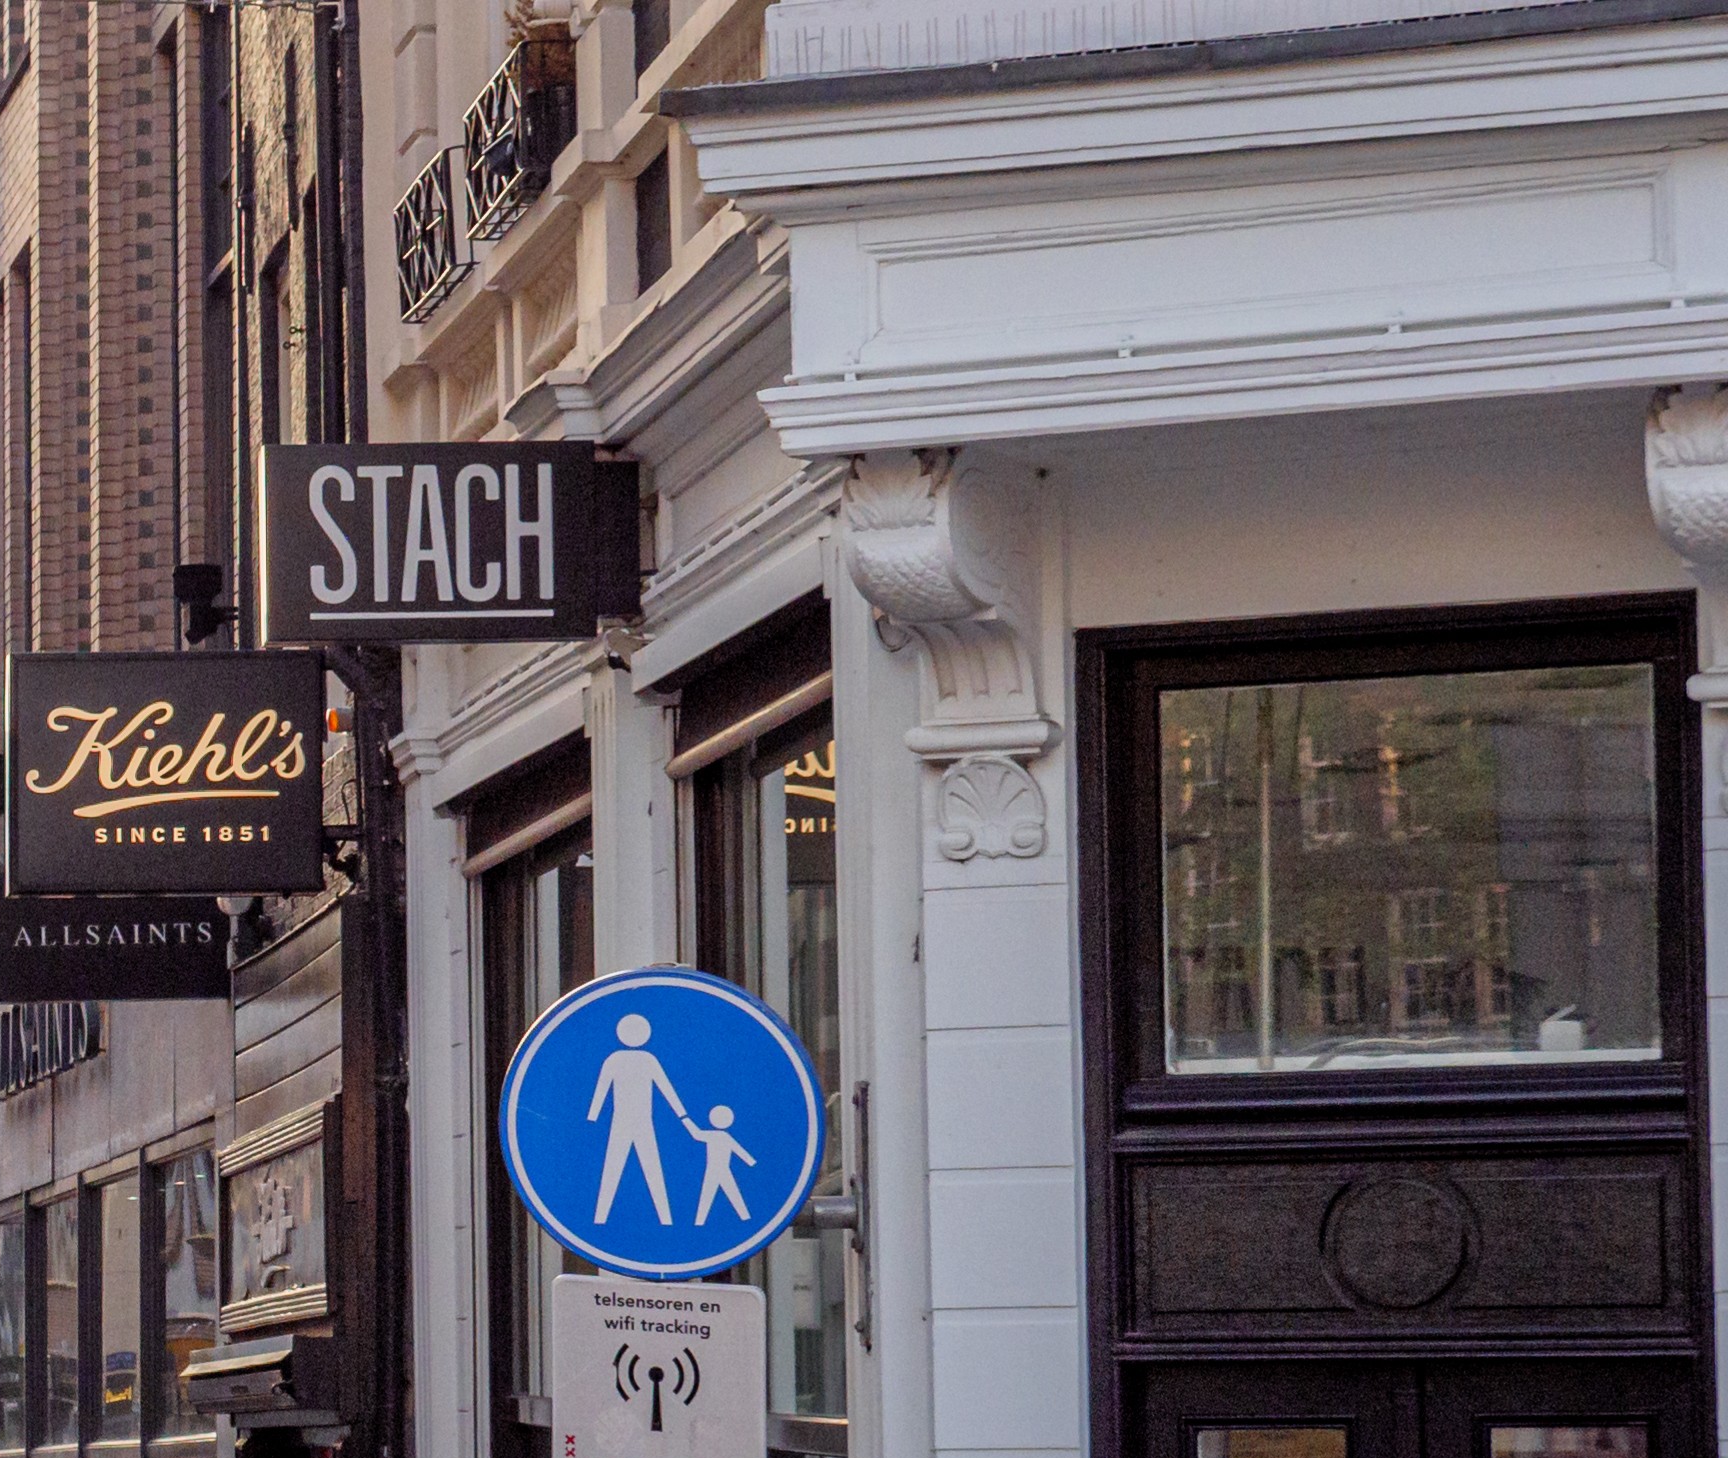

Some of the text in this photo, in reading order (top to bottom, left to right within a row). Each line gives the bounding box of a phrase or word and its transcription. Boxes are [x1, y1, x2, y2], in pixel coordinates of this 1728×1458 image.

[308, 462, 555, 604] STACH
[25, 700, 306, 795] Kiehl's
[94, 825, 270, 843] SINCE 1851
[13, 921, 213, 947] ALLSAINTS
[594, 1292, 721, 1313] telsensoren en
[604, 1316, 711, 1339] wifi tracking
